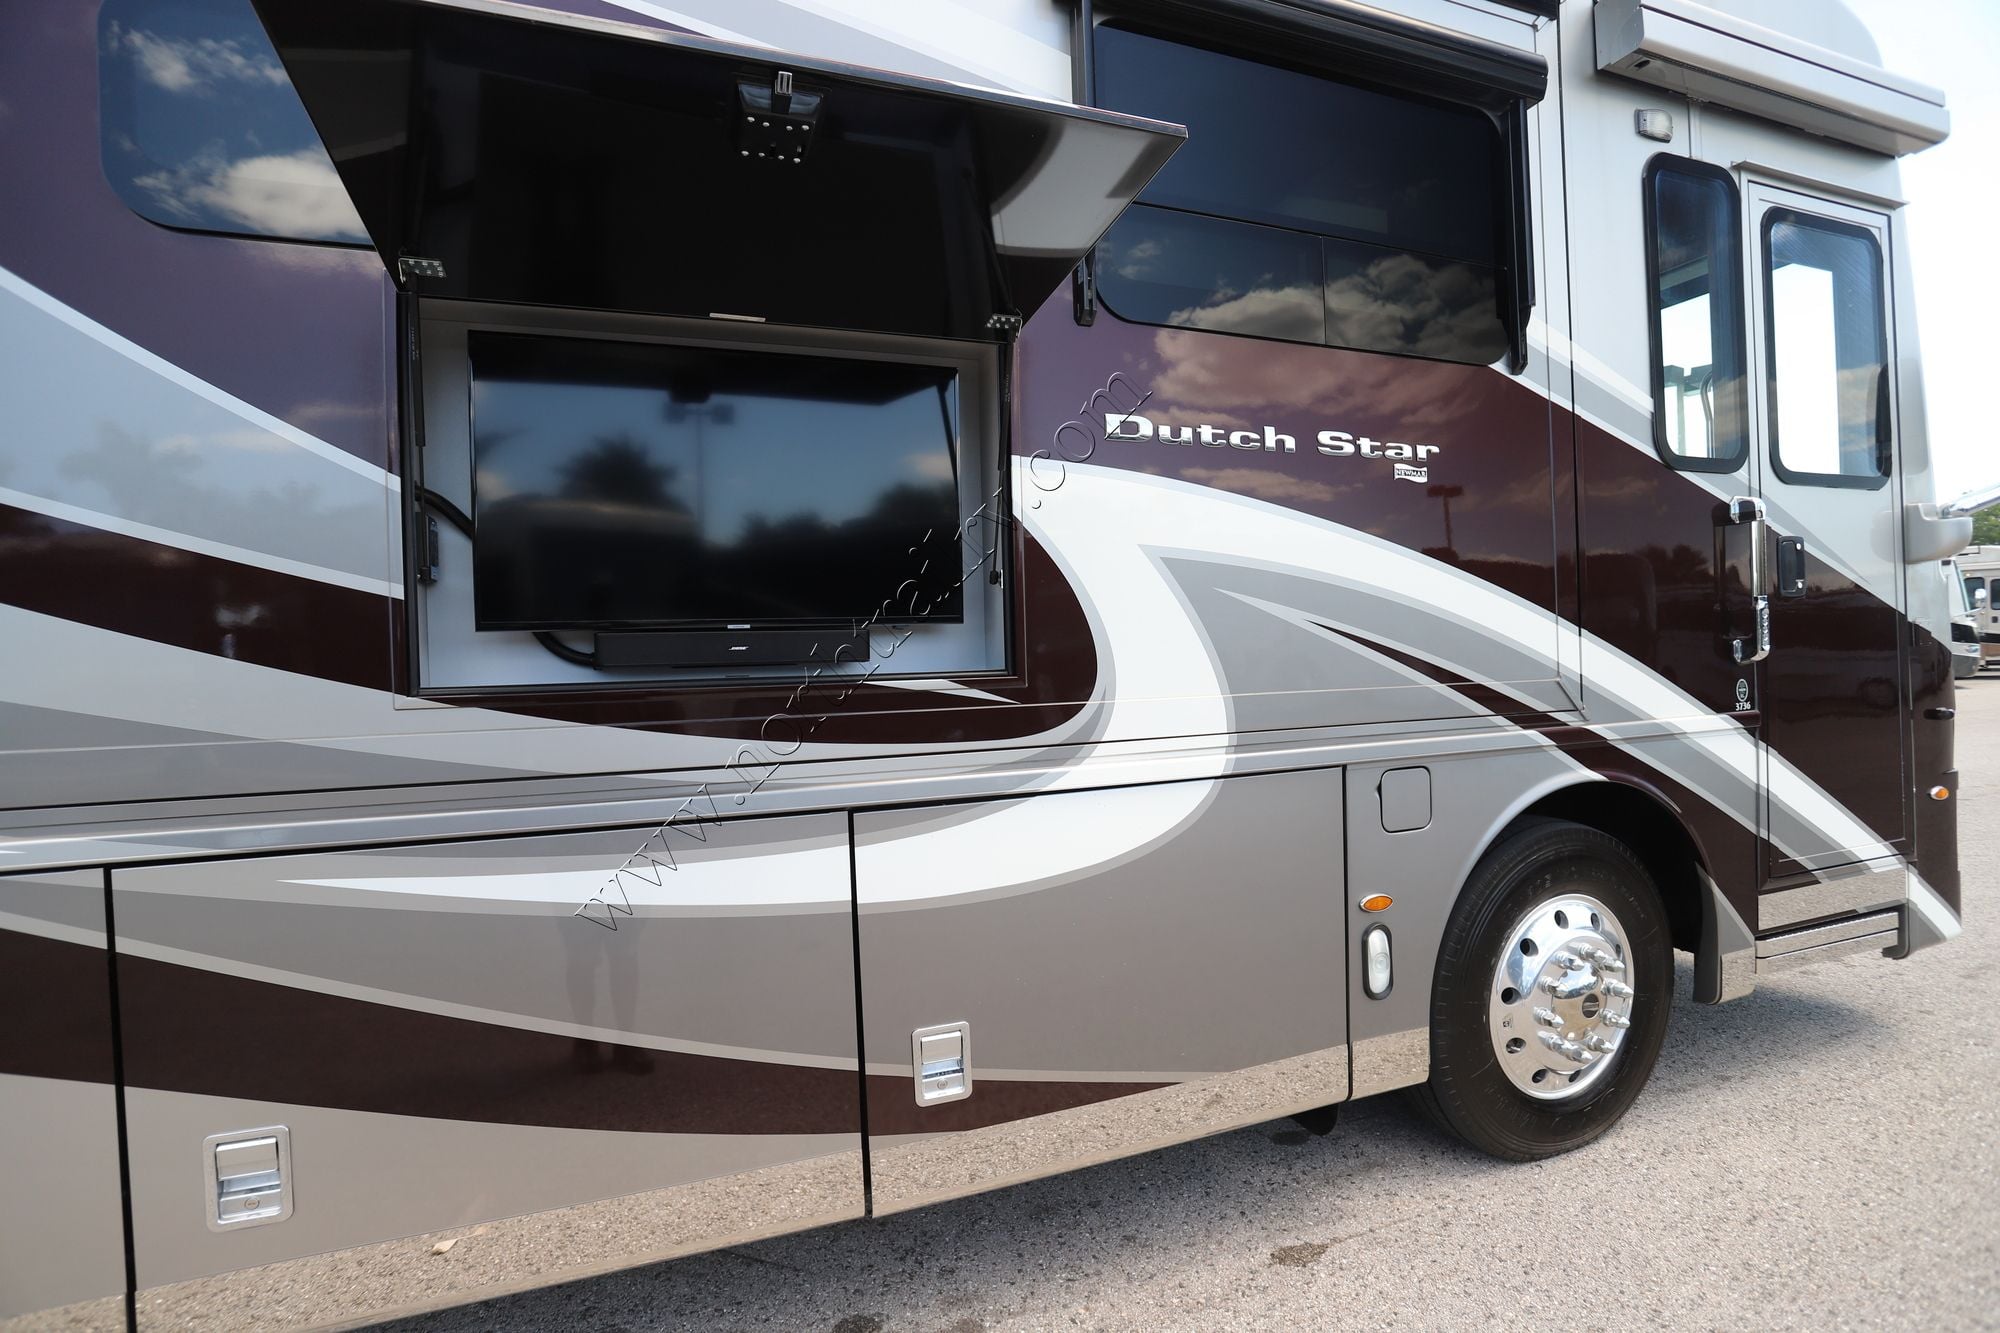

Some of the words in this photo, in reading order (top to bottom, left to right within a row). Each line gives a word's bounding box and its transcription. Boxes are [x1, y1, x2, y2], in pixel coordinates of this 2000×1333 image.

[1104, 412, 1296, 453] Dutch
[1316, 429, 1440, 462] Star
[1395, 468, 1427, 478] NEWMAR
[1735, 701, 1751, 711] 3736
